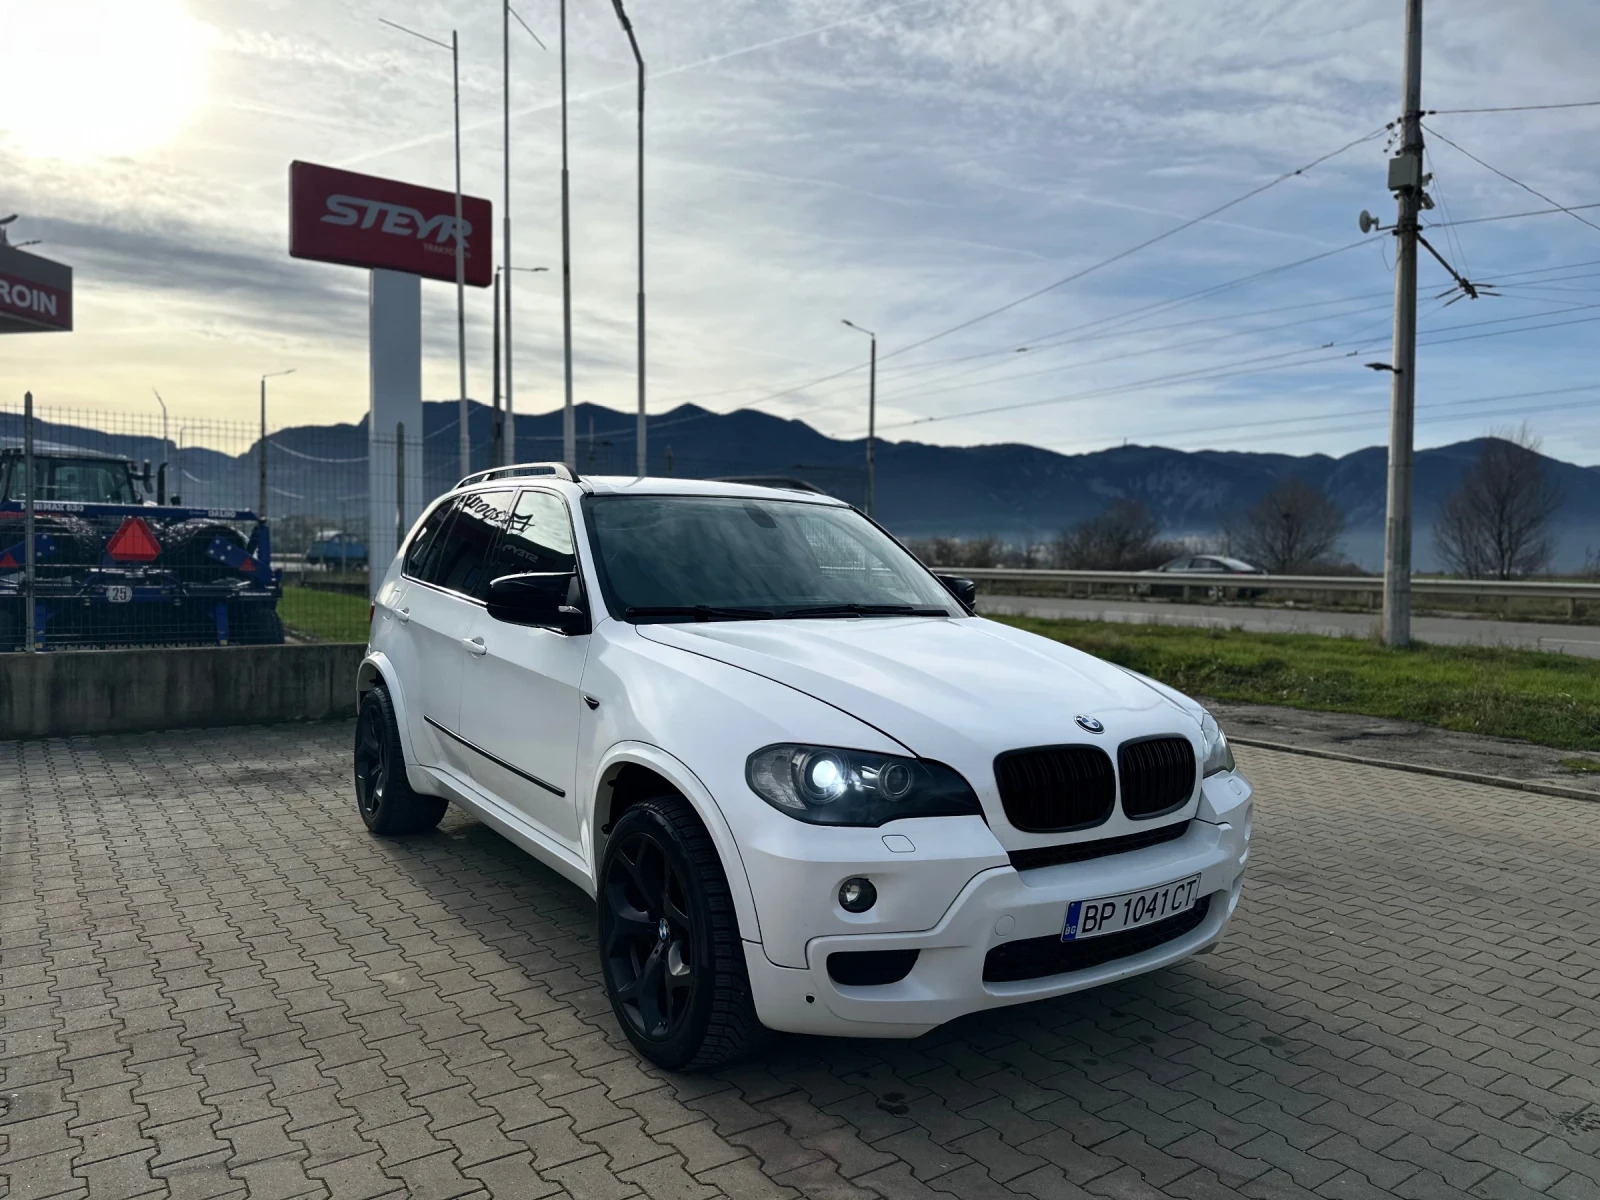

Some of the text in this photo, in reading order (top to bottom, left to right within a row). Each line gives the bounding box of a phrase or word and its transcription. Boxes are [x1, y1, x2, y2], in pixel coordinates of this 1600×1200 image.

[320, 194, 472, 249] STEYR
[112, 587, 127, 601] 25
[1082, 880, 1197, 933] BP 1041 CT
[1065, 925, 1077, 935] BG
